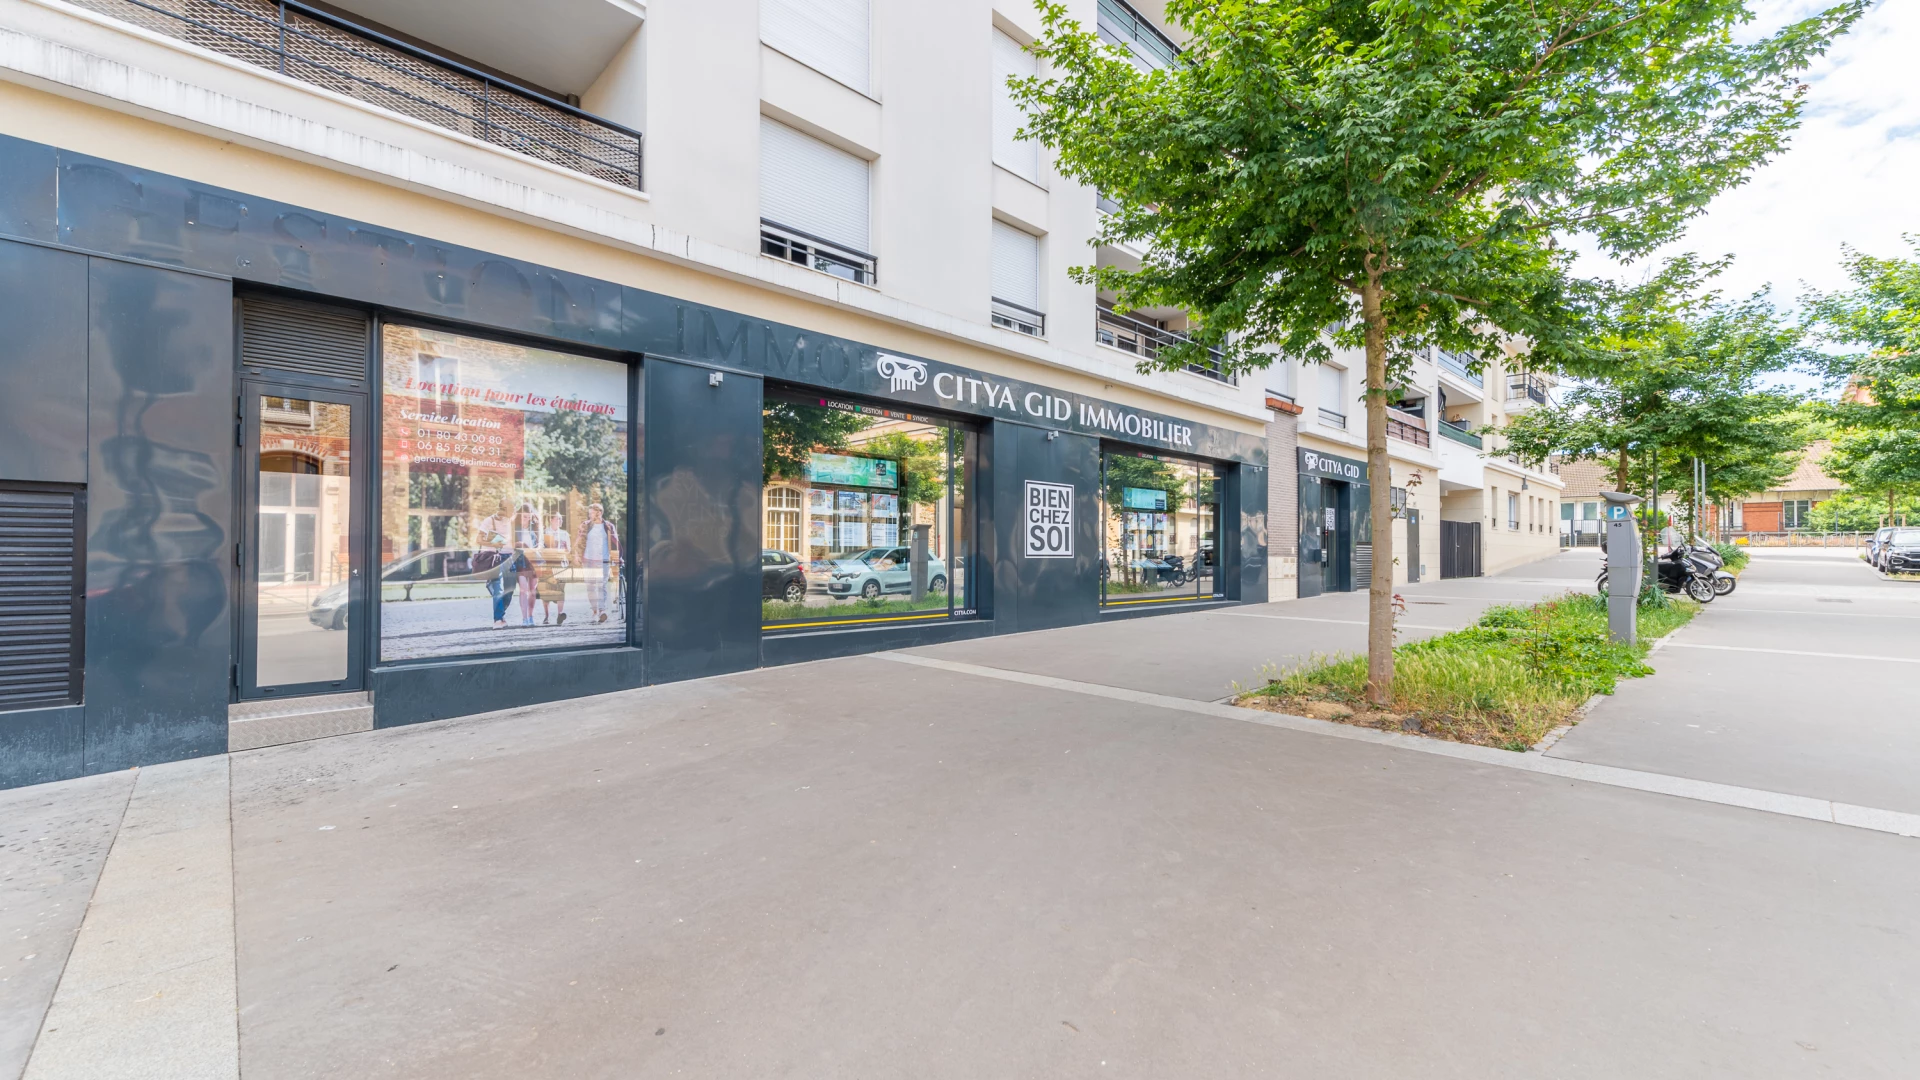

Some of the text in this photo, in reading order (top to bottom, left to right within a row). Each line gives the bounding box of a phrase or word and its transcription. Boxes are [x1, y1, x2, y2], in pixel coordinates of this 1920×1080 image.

[405, 377, 616, 415] Location pour les étudiants
[399, 409, 501, 430] Service location
[827, 401, 929, 423] LOCATION GESTION VENTE SYNDIC
[933, 372, 1192, 446] CITYA GID IMMOBILIER
[417, 428, 502, 445] 01 80 43 00 80
[417, 440, 501, 456] 06 85 87 69 31
[414, 455, 517, 469] gerance@gidimmo.com
[1319, 457, 1360, 479] CITYA GID
[1030, 487, 1070, 509] BIEN
[1029, 508, 1070, 525] CHEZ
[1613, 506, 1625, 520] P
[1030, 524, 1070, 552] SOI
